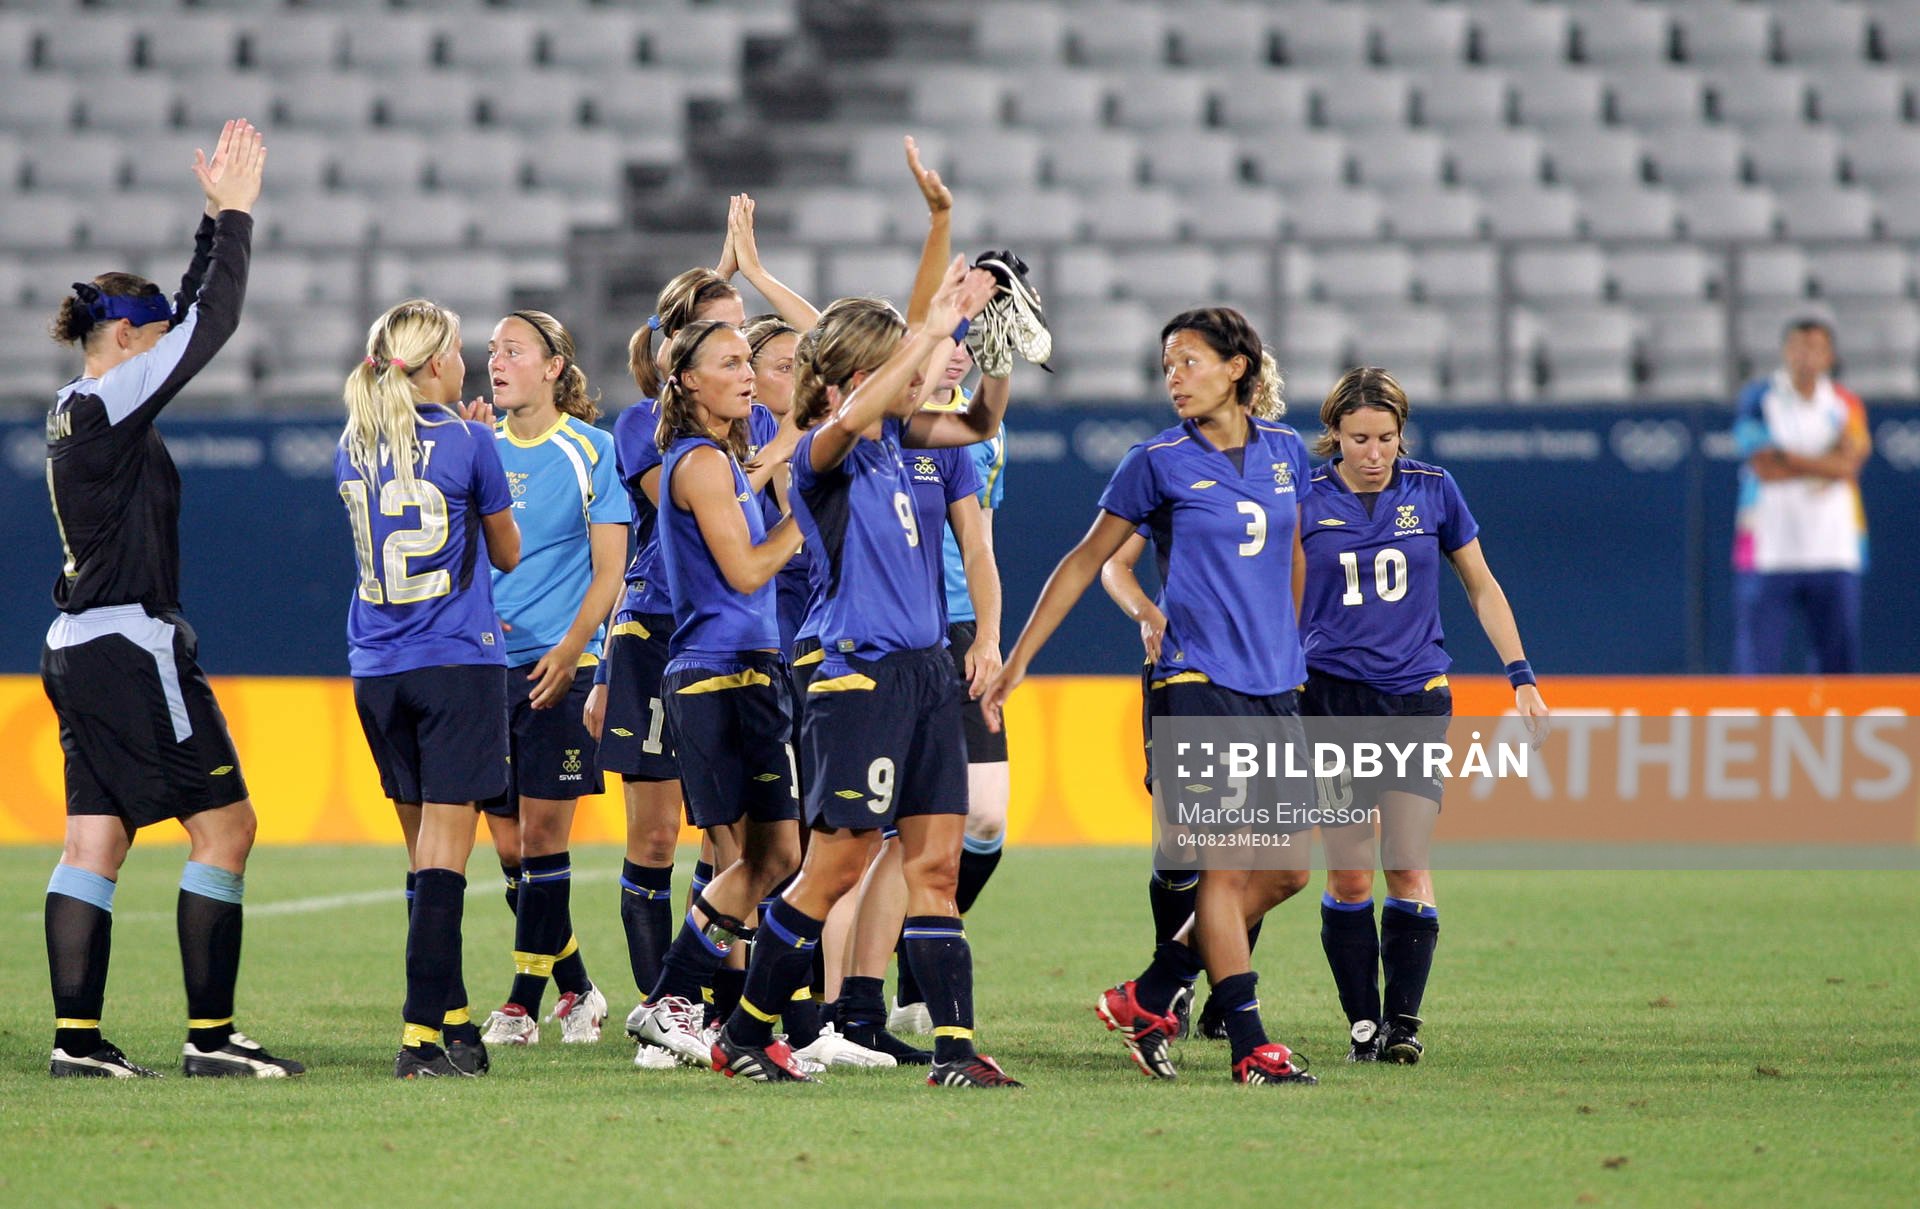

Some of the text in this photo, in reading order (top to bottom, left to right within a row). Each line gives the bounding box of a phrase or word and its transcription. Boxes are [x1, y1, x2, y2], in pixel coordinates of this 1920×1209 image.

[339, 479, 451, 605] 12
[894, 492, 919, 548] 9
[1236, 501, 1267, 557] 3
[1394, 528, 1425, 537] SWE
[1339, 548, 1408, 606] 10
[1470, 706, 1912, 802] ATHENS
[867, 757, 895, 814] 9
